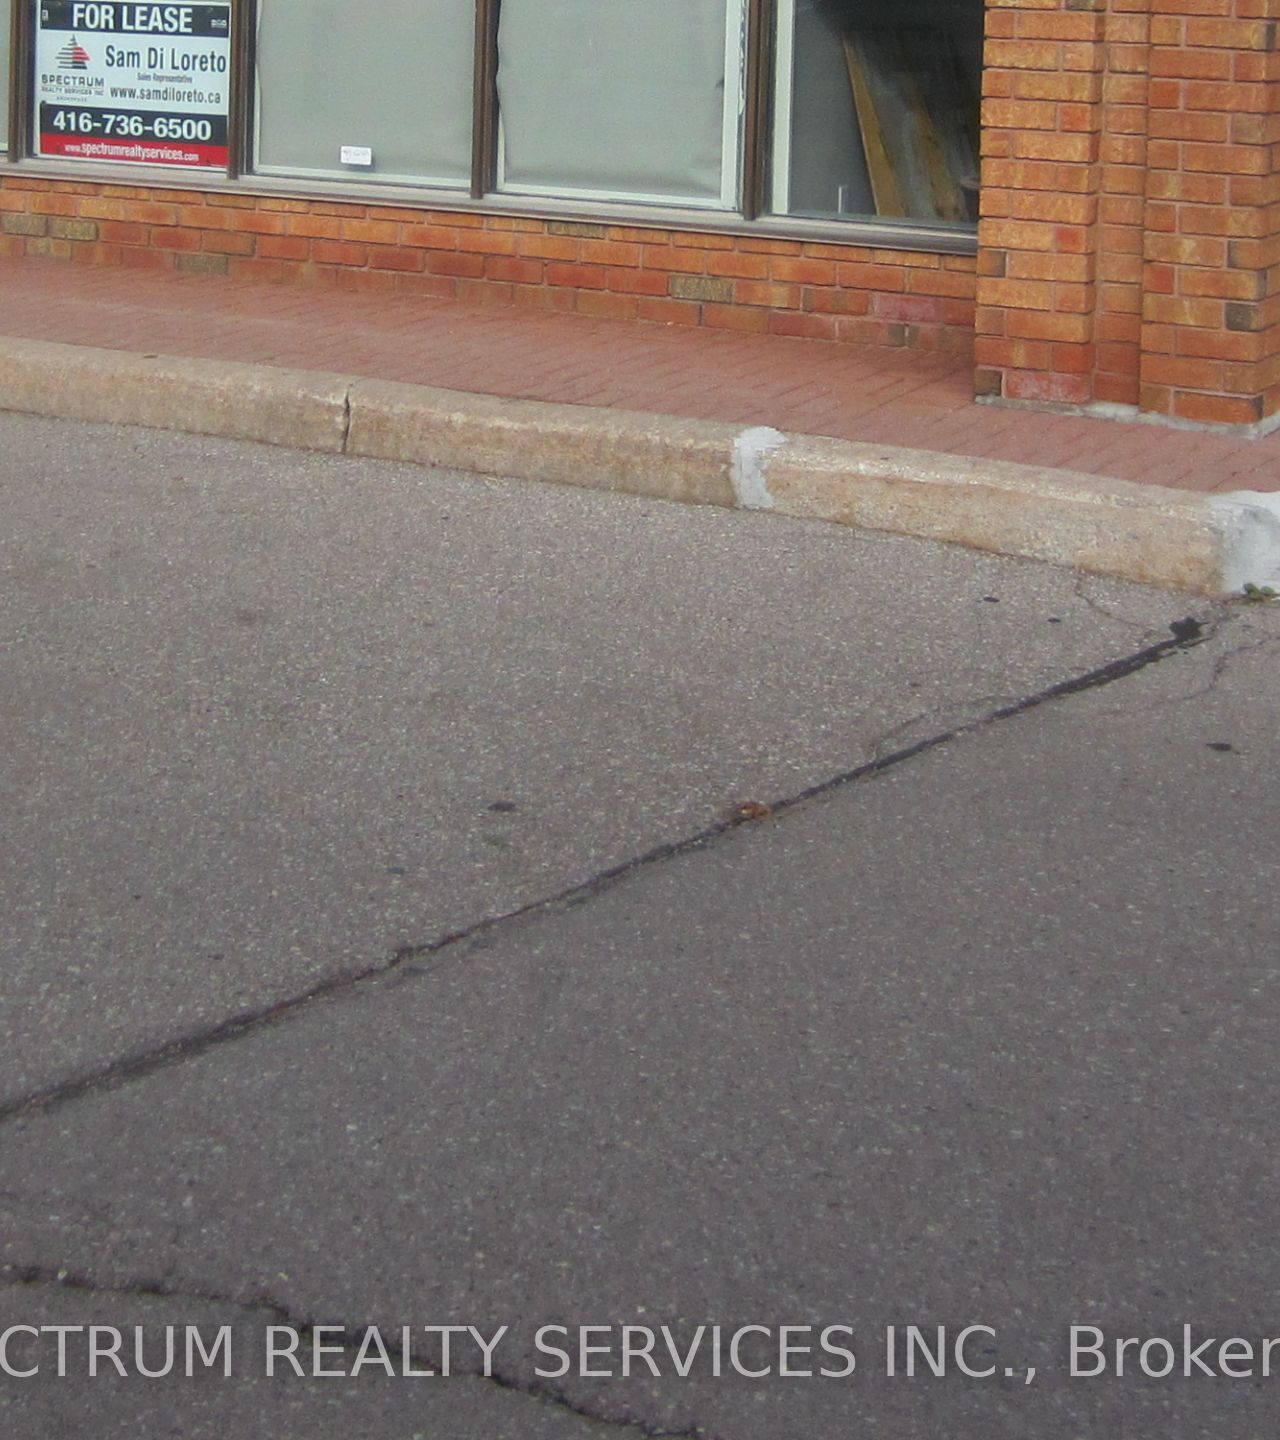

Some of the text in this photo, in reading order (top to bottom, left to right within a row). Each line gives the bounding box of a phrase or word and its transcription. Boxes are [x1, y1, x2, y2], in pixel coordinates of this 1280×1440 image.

[72, 3, 192, 33] FOR LEASE
[105, 45, 227, 73] Sam Di Loreto
[41, 74, 104, 87] SPECTRUM
[110, 86, 221, 104] www.samdiloreto.ca
[53, 110, 212, 141] 416-736-6500
[64, 142, 199, 162] www.spectrumrealtyservices.com
